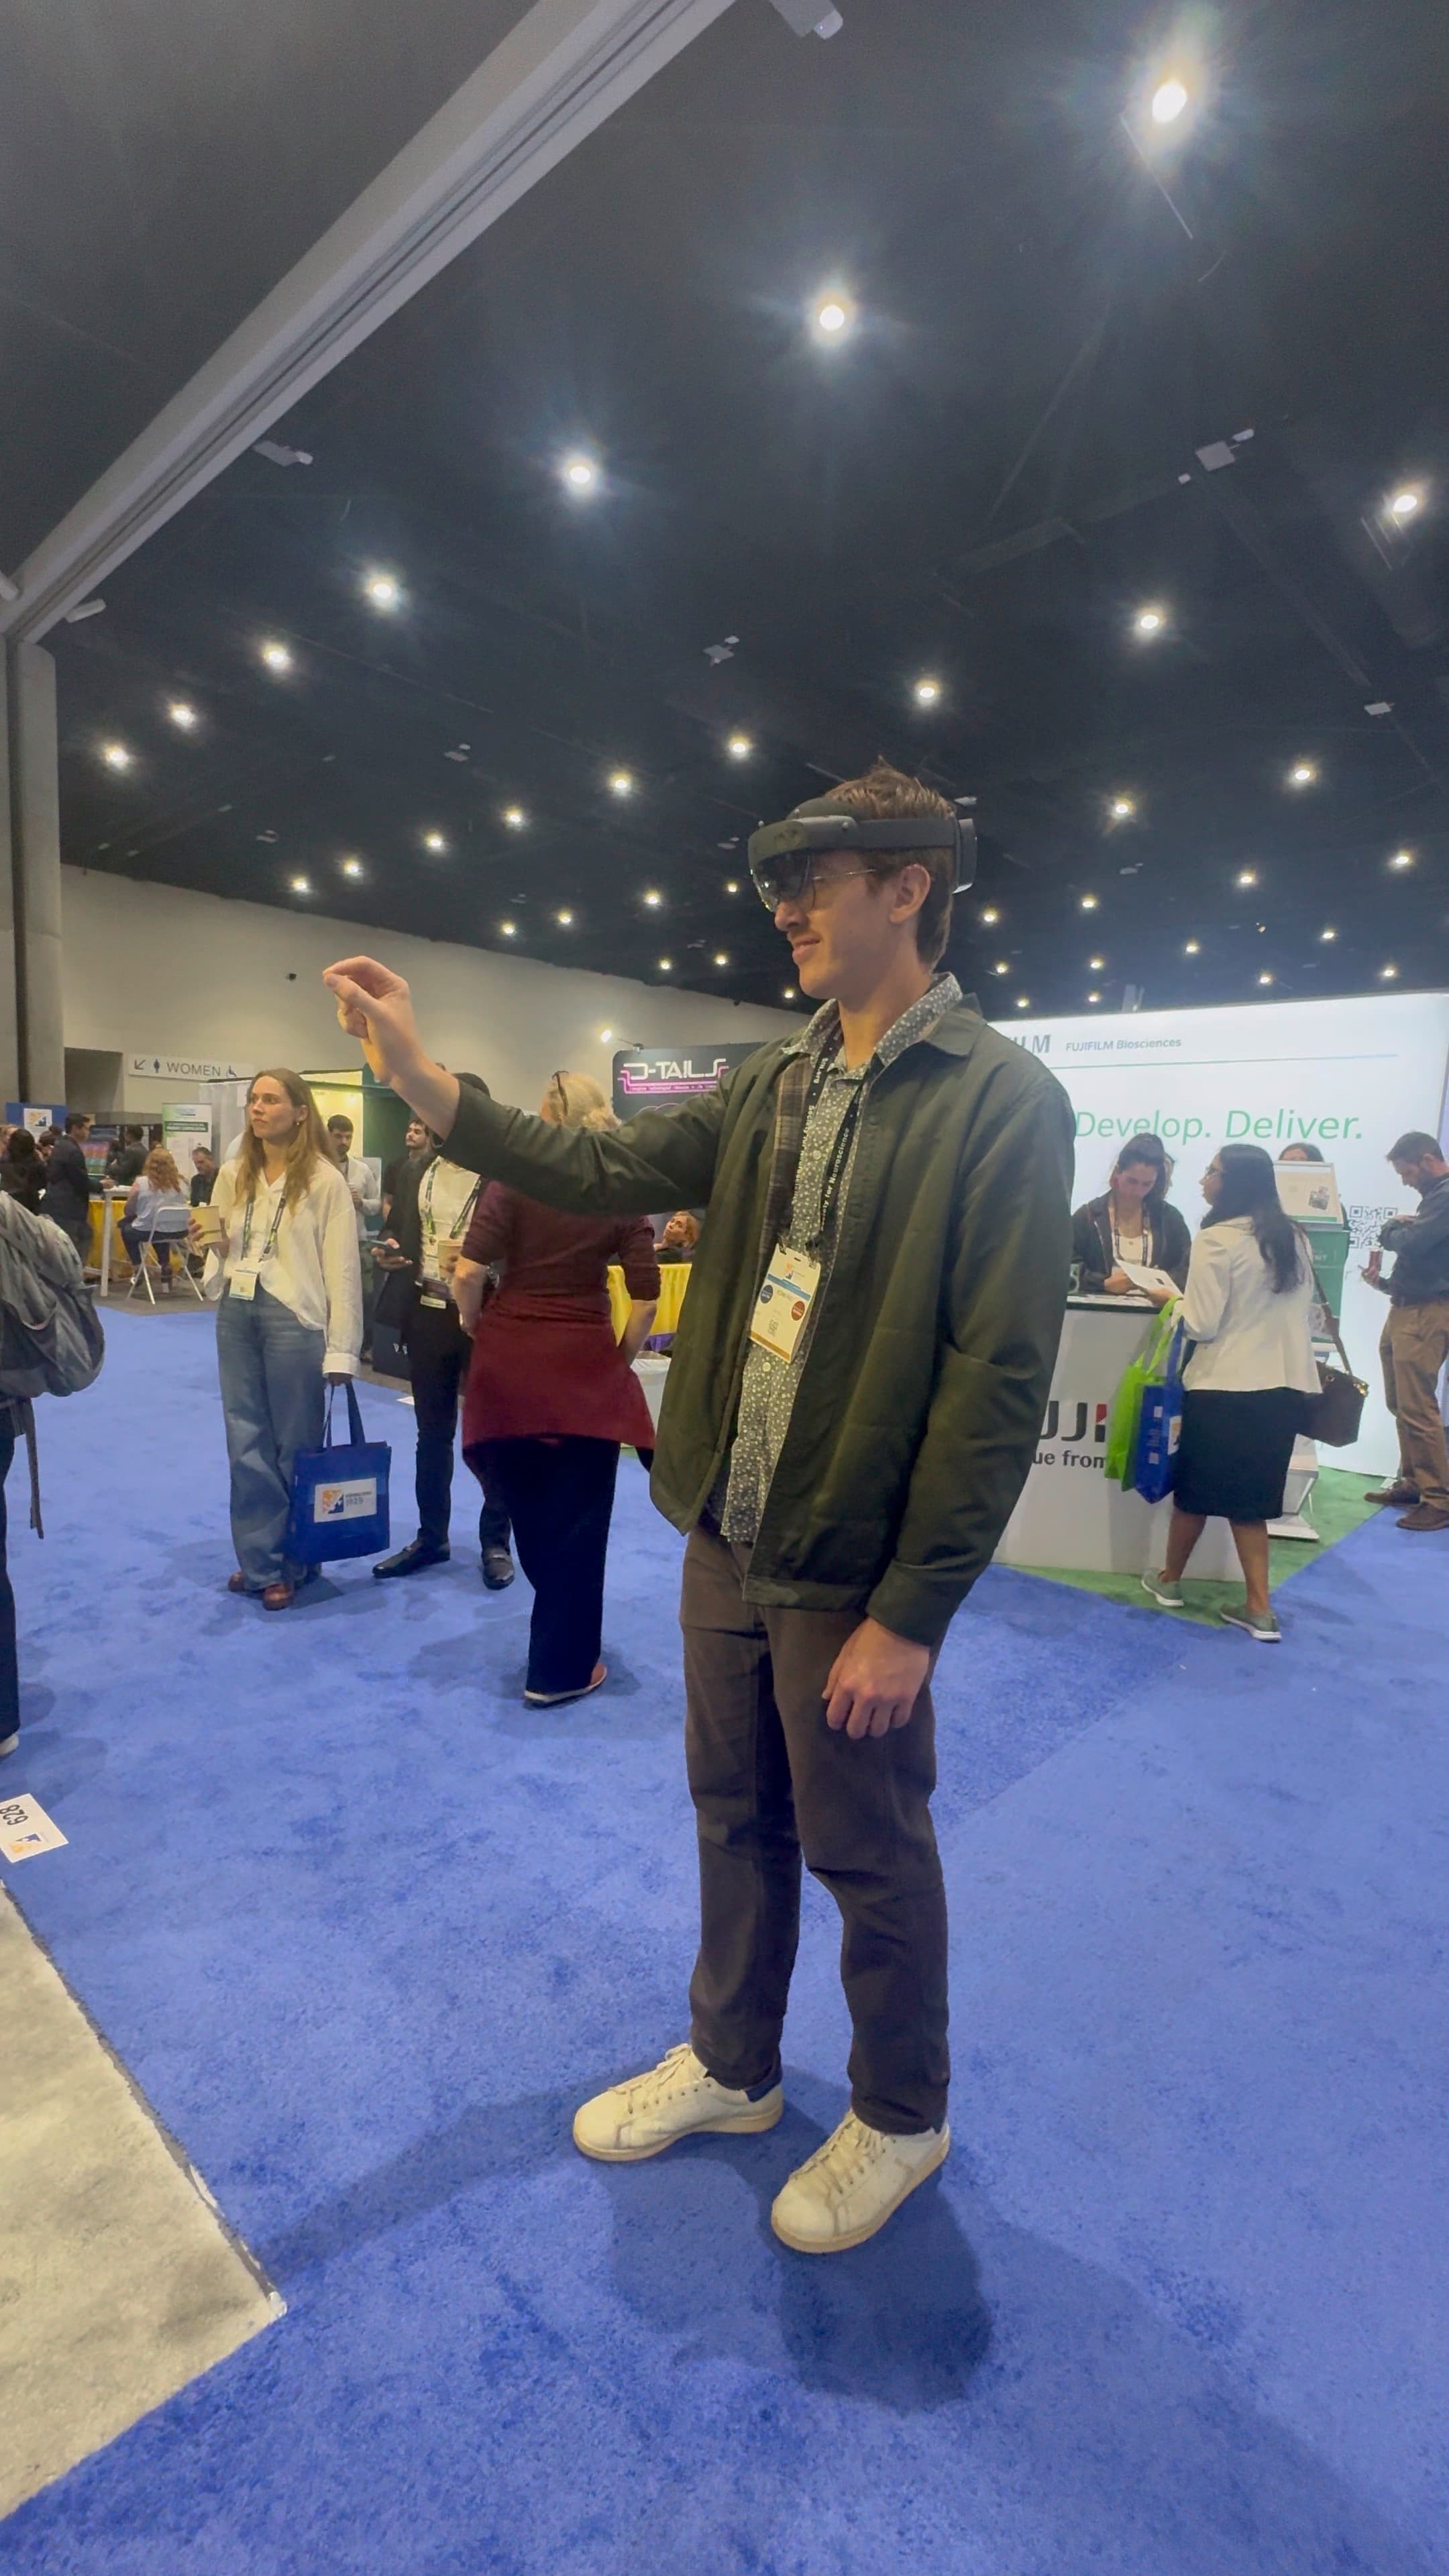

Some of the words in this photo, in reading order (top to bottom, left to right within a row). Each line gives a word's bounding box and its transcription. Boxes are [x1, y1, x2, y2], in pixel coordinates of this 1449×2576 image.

[1066, 1040, 1114, 1052] FUJIFILM
[1116, 1038, 1181, 1049] Biosciences
[166, 1062, 221, 1076] WOMEN
[1075, 1110, 1211, 1144] Develop.
[1226, 1109, 1362, 1139] Deliver.
[828, 1128, 851, 1184] Neuroscience
[0, 1805, 28, 1825] 628
